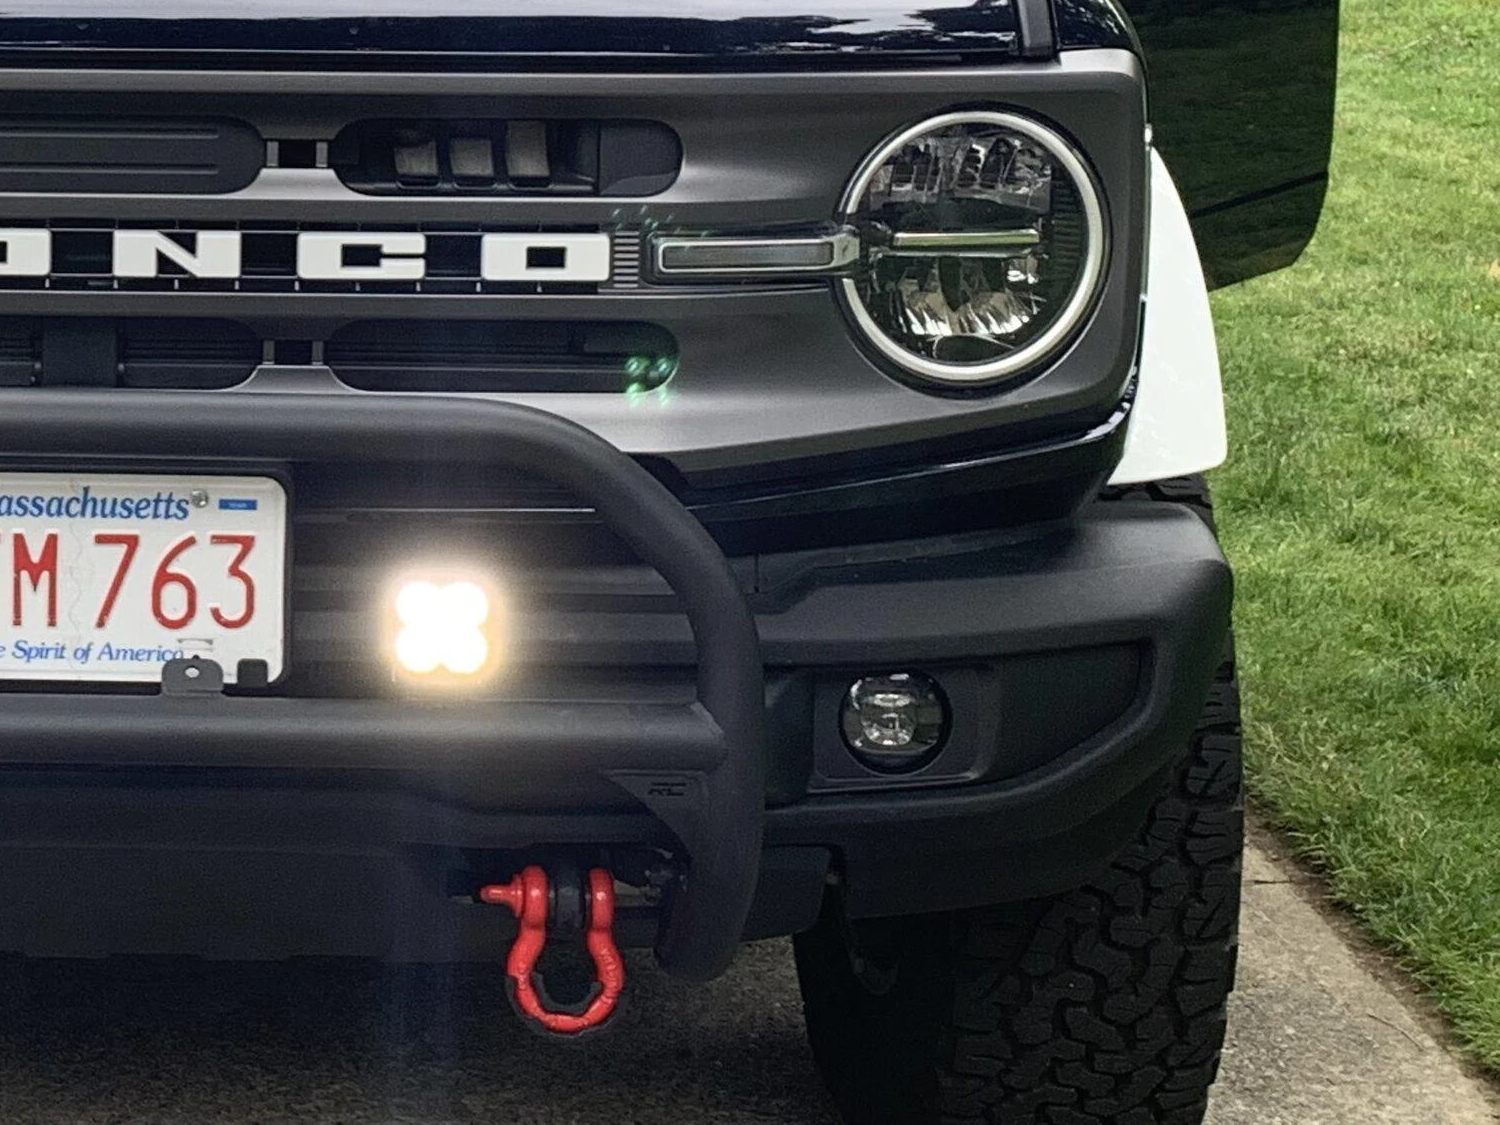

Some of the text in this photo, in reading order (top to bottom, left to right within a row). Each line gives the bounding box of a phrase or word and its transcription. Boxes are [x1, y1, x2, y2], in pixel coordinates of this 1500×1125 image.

[94, 534, 256, 630] 763
[12, 639, 67, 663] Spirit
[74, 641, 94, 664] of
[97, 642, 184, 662] America
